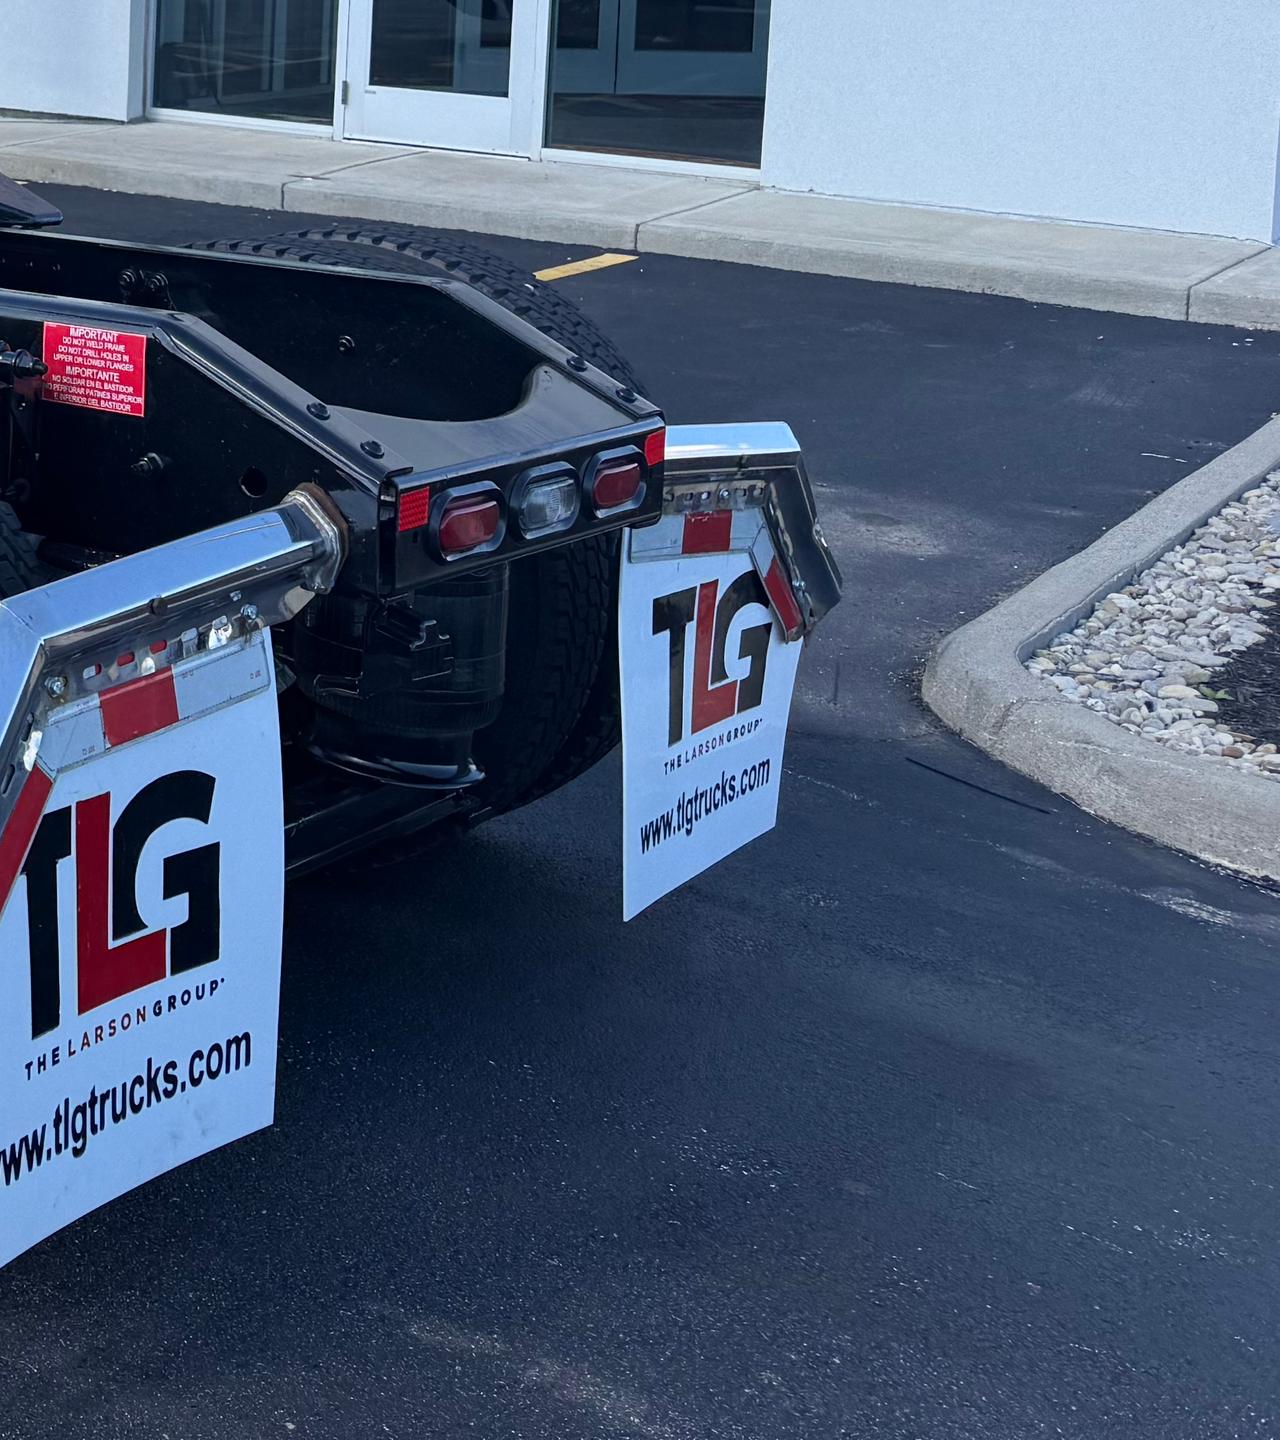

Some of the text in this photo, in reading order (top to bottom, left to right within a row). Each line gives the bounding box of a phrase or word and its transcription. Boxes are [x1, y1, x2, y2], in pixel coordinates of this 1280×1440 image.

[62, 336, 126, 352] DO NOT WELD FRAME
[70, 327, 119, 343] IMPORTANT
[54, 353, 134, 372] UPPER OR LOWER FLANGES
[68, 346, 81, 354] NOT
[83, 348, 100, 358] DRILL
[101, 351, 122, 361] HOLES
[122, 354, 129, 362] IN
[52, 374, 134, 394] NO SOLDAR EN EL BASTIDOR
[65, 366, 120, 383] IMPORTANTE
[53, 383, 85, 395] PERFORAR
[86, 388, 111, 399] PATINES
[111, 393, 143, 404] SUPERIOR
[60, 393, 87, 405] INFERIOR
[88, 398, 100, 407] DEL
[101, 399, 131, 412] BASTIDOR
[652, 569, 773, 748] TLG
[663, 720, 760, 776] THE LARSON GROUP
[640, 757, 771, 855] www.tlgtrucks.com
[19, 769, 221, 1041] TLG
[24, 979, 219, 1081] THE LARSON GROUP
